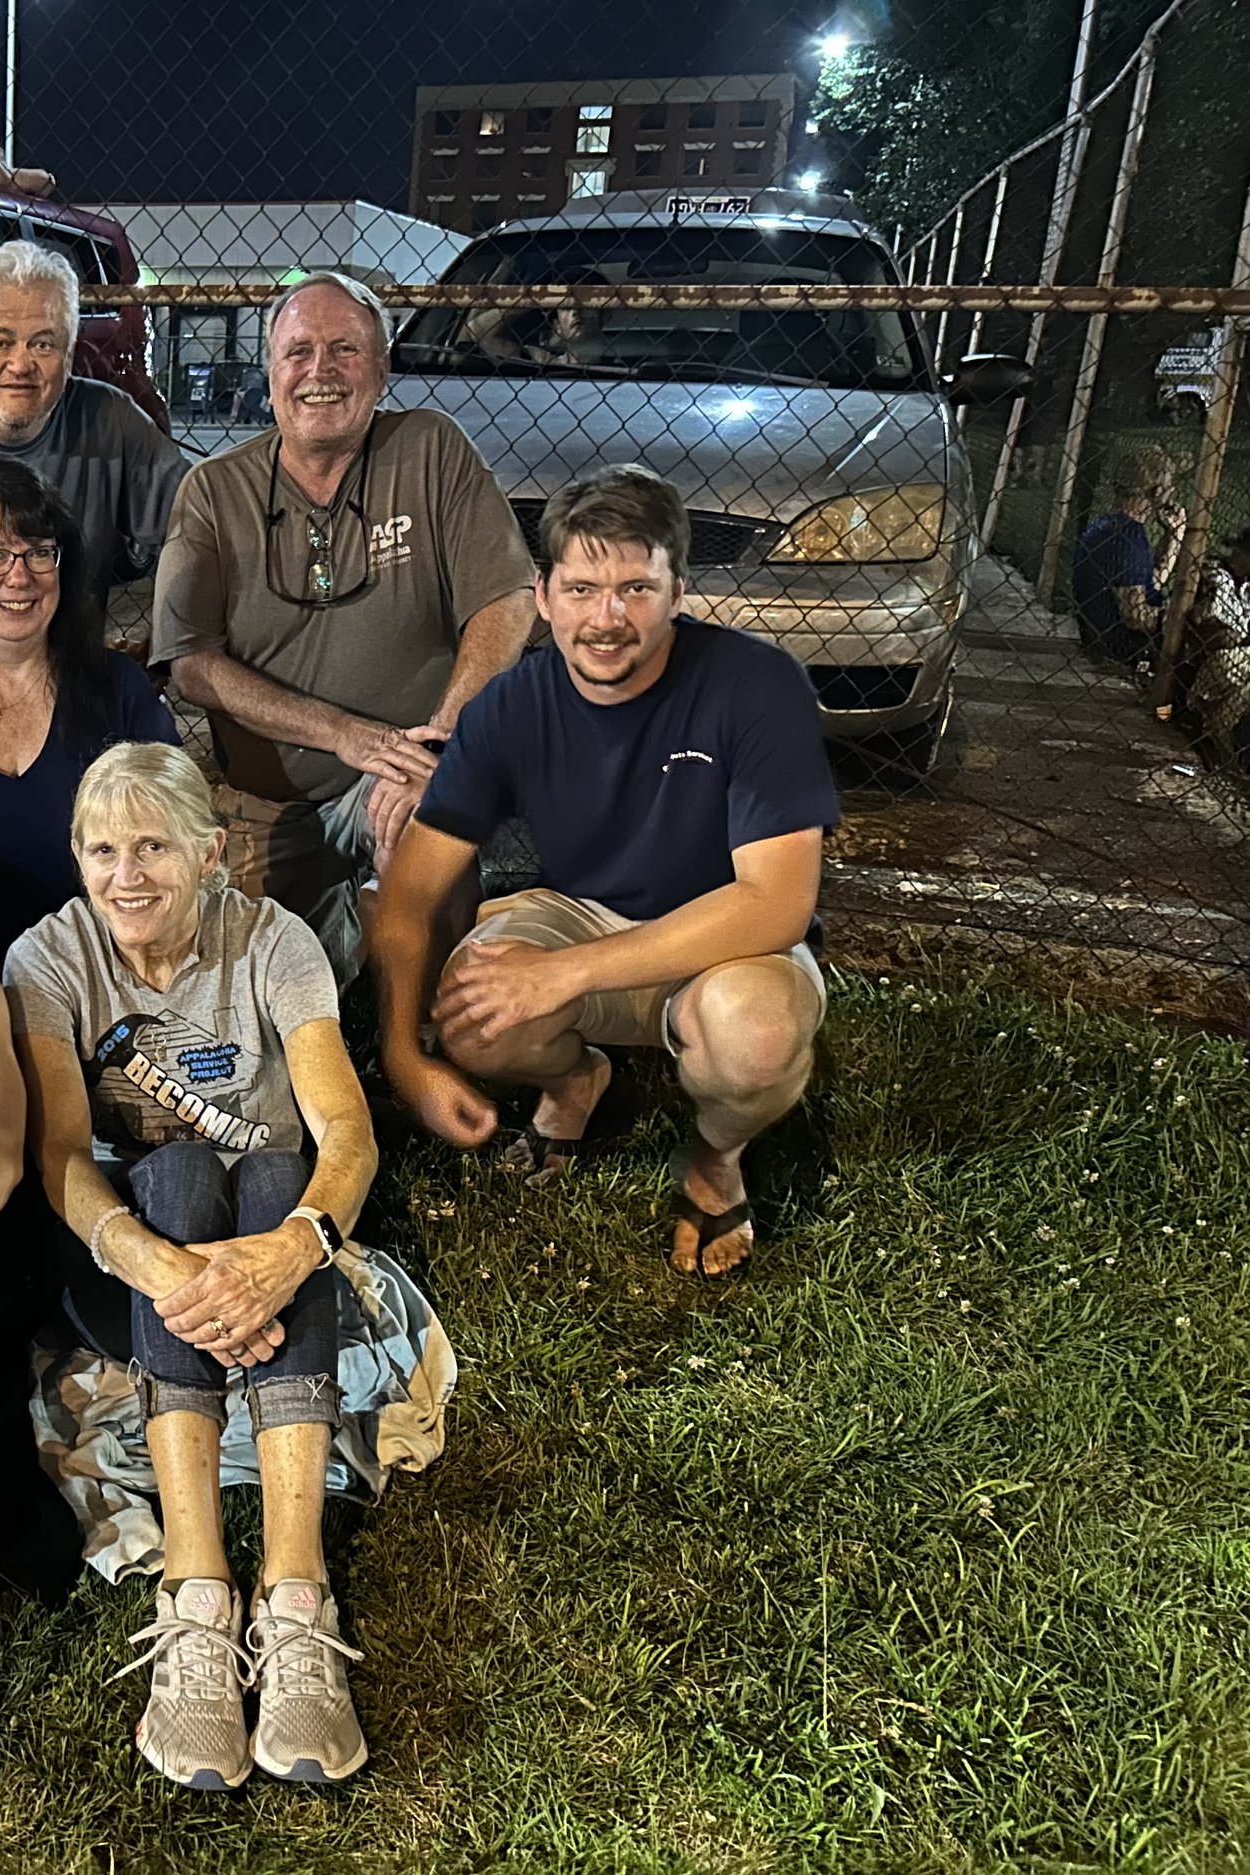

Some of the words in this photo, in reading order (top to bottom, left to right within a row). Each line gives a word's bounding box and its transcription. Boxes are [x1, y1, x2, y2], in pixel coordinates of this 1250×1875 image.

[369, 515, 412, 552] ASP
[96, 1023, 130, 1063] 2015
[180, 1046, 237, 1063] APPALACHIA
[190, 1058, 228, 1069] SERVICE
[190, 1065, 233, 1080] PROJECT
[123, 1050, 271, 1150] BECOMING
